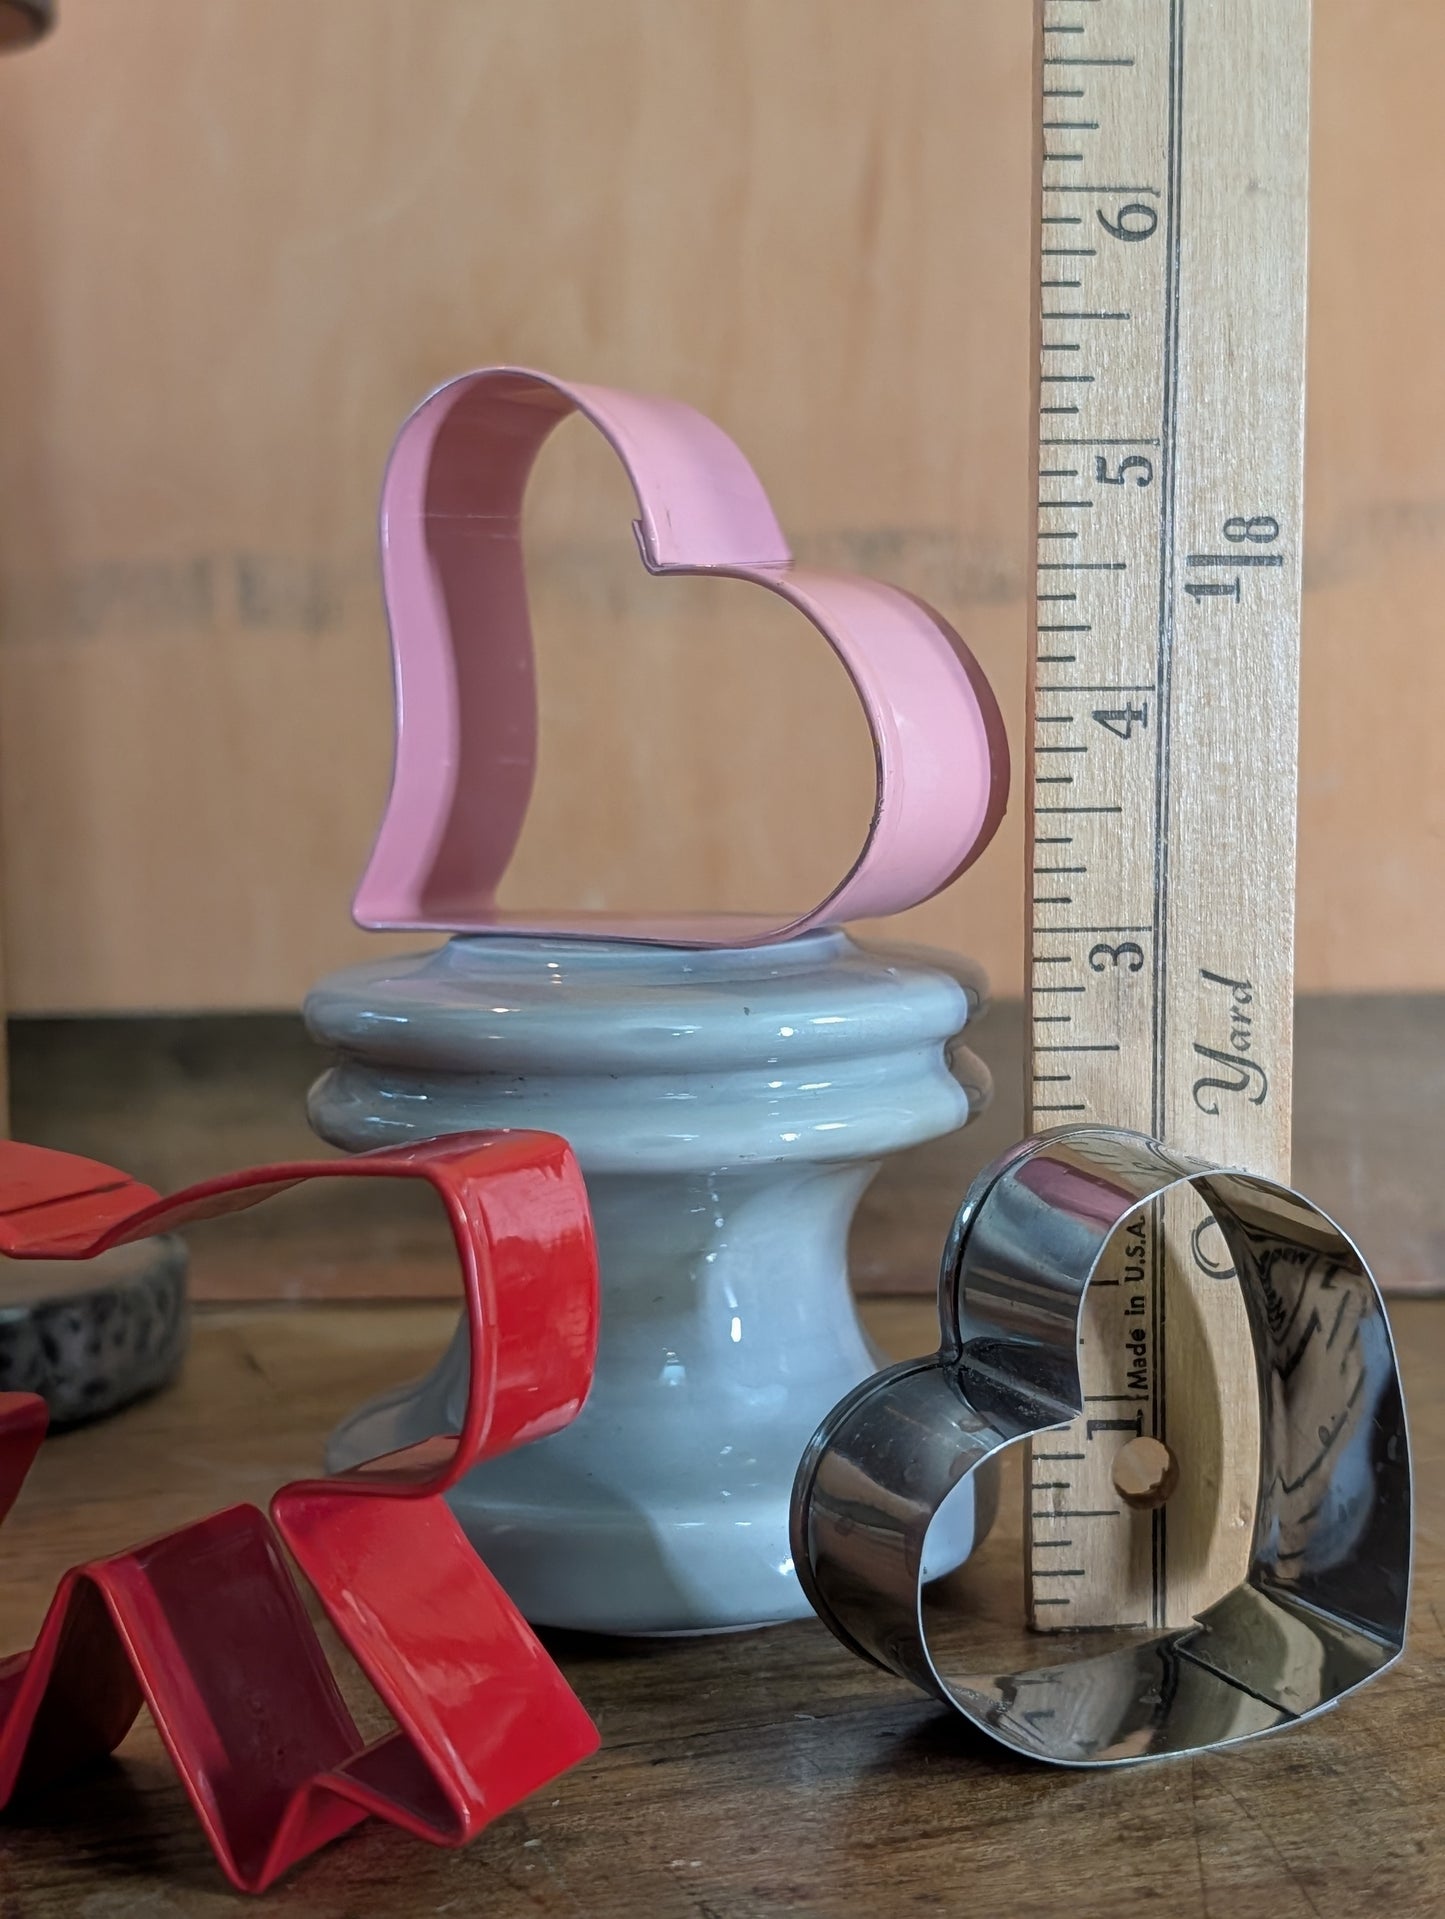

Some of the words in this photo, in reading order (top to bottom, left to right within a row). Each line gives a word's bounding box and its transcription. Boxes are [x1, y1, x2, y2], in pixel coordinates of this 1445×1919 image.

[1096, 203, 1158, 242] 6
[1096, 455, 1154, 487] 5
[1092, 702, 1149, 739] 4
[1088, 941, 1145, 973] 3
[1191, 969, 1268, 1116] Yard
[1124, 1214, 1147, 1284] U.S.A.
[1124, 1294, 1147, 1315] in
[1126, 1327, 1149, 1391] Made
[1087, 1409, 1144, 1441] 1
